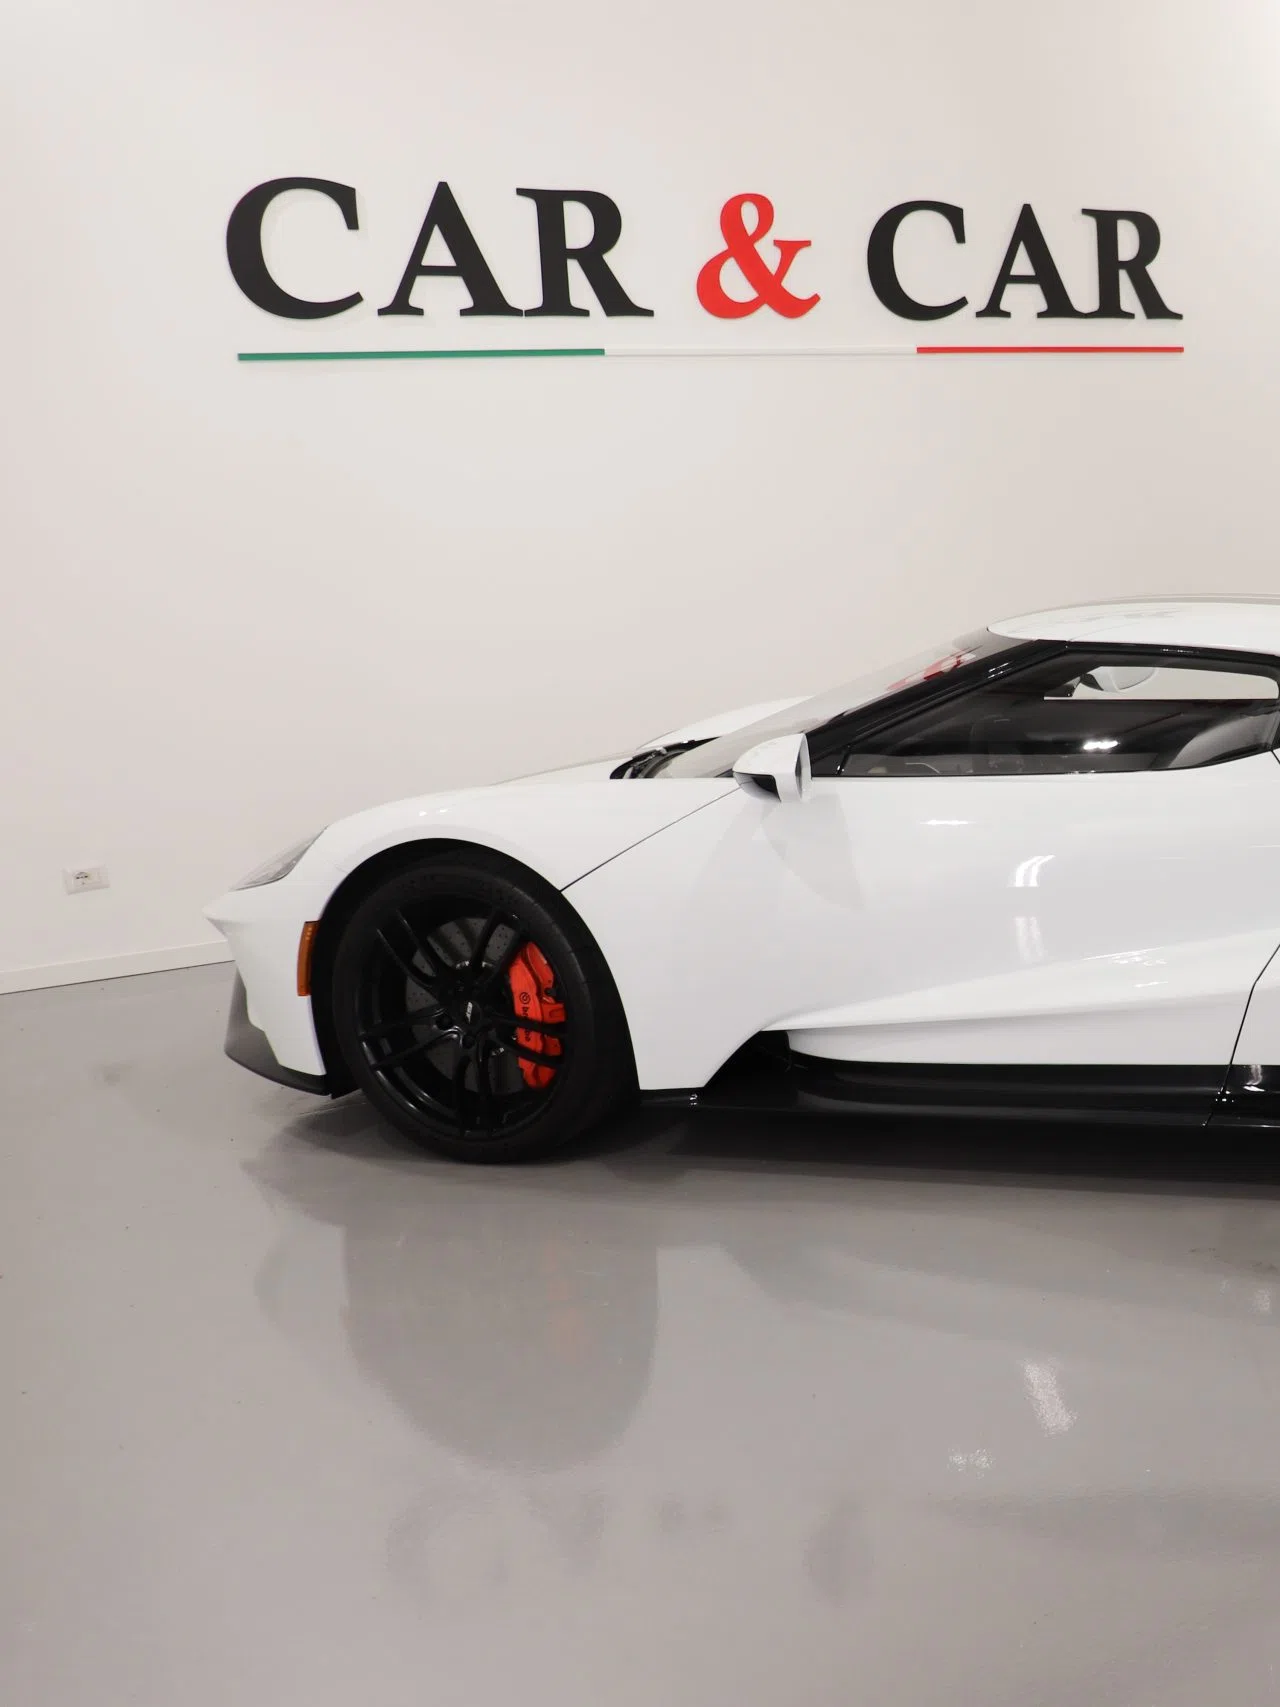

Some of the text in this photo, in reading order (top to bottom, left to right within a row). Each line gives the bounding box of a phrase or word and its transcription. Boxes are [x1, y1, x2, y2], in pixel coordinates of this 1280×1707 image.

[226, 176, 1184, 321] CAR & CAR
